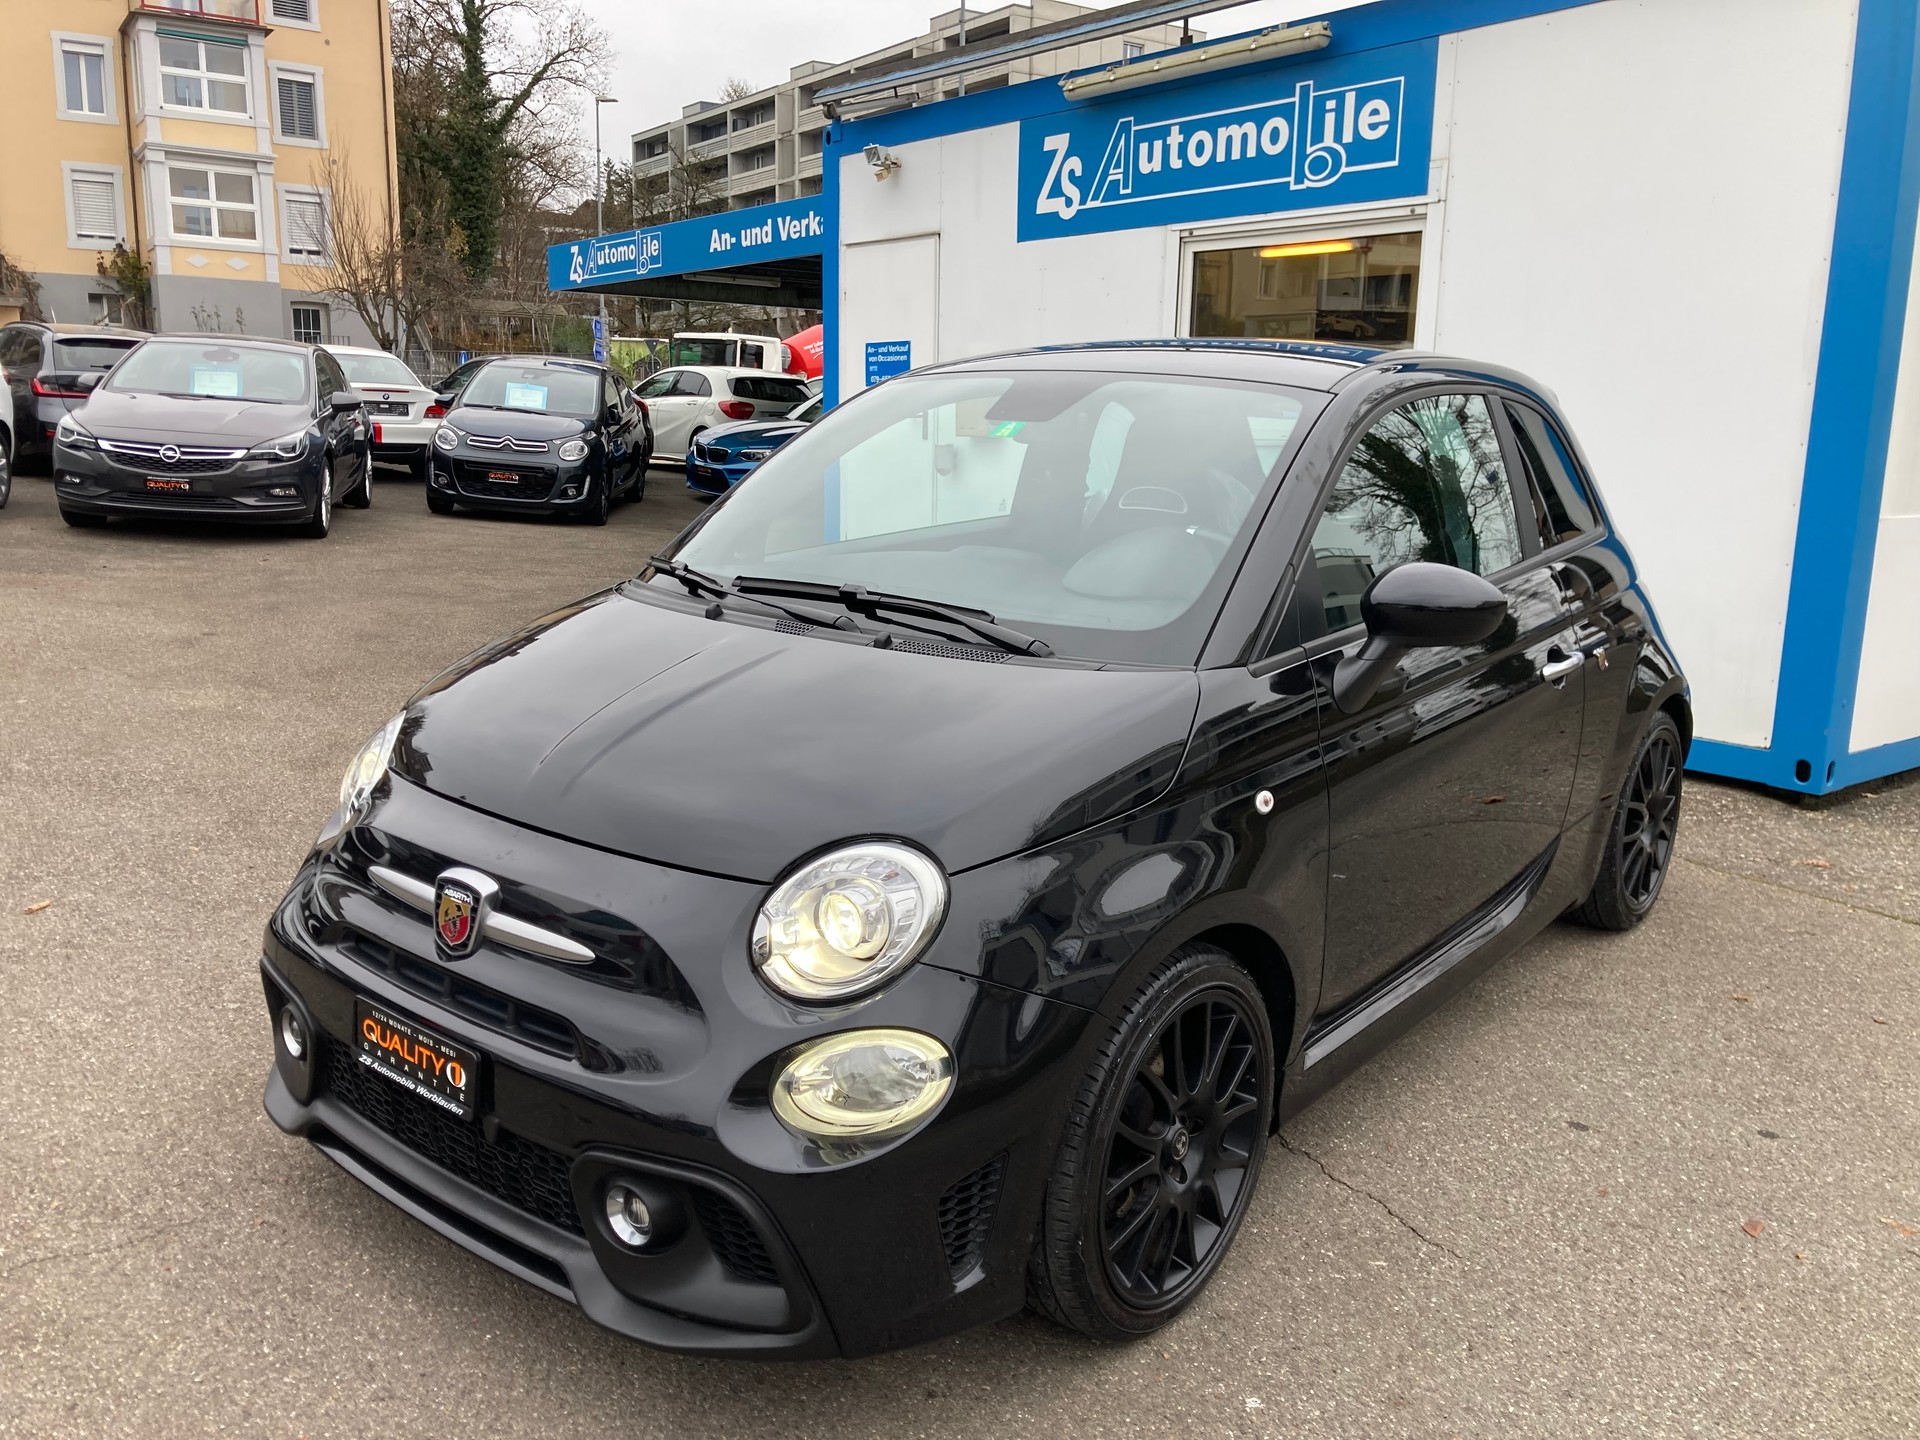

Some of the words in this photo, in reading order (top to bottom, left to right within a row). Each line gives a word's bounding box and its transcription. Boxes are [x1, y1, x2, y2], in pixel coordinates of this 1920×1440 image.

[1087, 80, 1392, 206] Automobile
[584, 231, 660, 276] Automobile
[710, 228, 737, 253] An-
[741, 219, 773, 247] und
[878, 345, 888, 353] und
[889, 344, 908, 352] Verkauf
[878, 354, 908, 362] Occasionen
[146, 480, 181, 489] QUALITY
[444, 888, 471, 903] ABARTH
[372, 1010, 387, 1023] 12/24
[388, 1018, 412, 1036] MONATE
[418, 1034, 434, 1047] MOIS
[440, 1046, 457, 1058] MESI
[358, 1054, 373, 1067] ZS
[371, 1062, 416, 1090] Automobile
[416, 1085, 464, 1116] Worblaufen
[363, 1042, 465, 1102] GARANTIE
